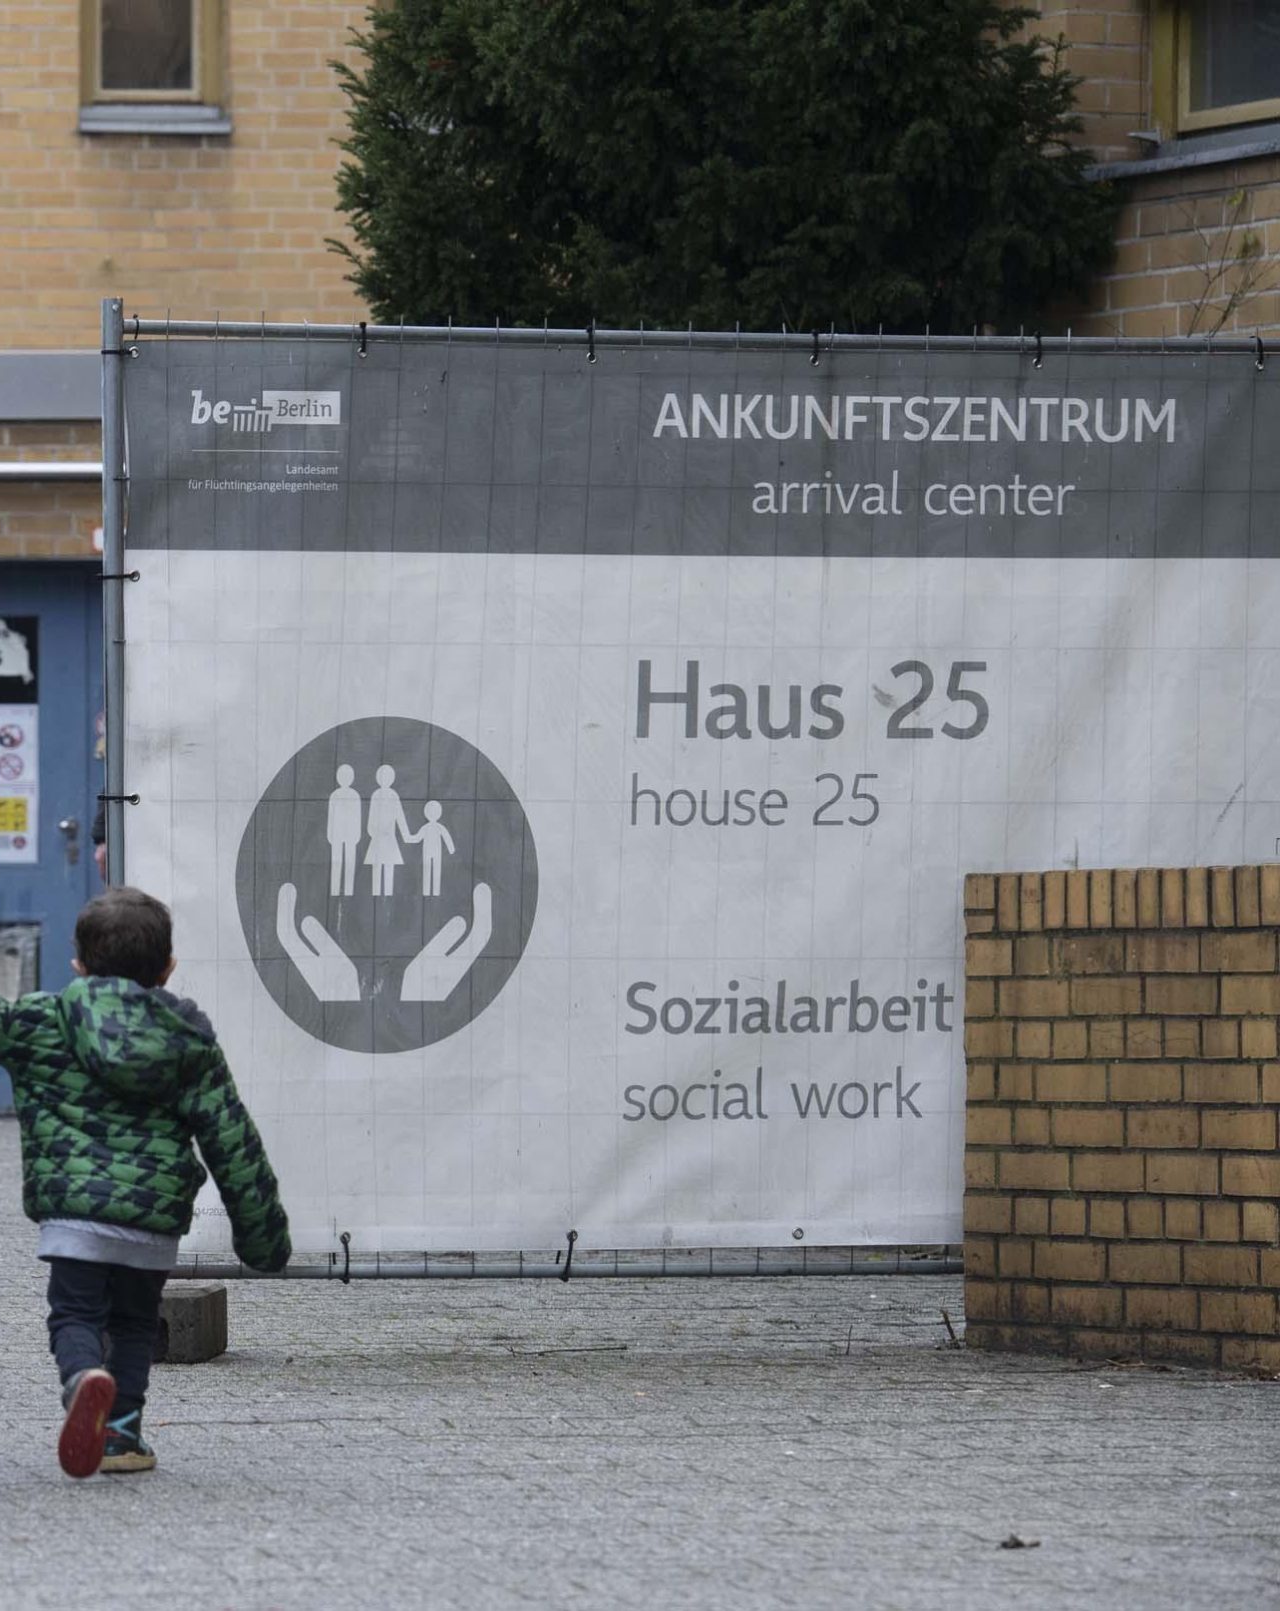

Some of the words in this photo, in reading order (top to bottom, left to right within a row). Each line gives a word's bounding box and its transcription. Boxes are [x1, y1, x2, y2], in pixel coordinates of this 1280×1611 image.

[191, 389, 232, 424] be
[276, 399, 333, 418] Berlin
[652, 392, 1177, 443] ANKUNFTSZENTRUM
[188, 478, 203, 490] für
[205, 479, 338, 493] Flüchtlingsangelegenheiten
[285, 463, 339, 475] Landesamt
[751, 470, 902, 515] arrival
[924, 475, 1075, 516] center
[635, 659, 845, 740] Haus
[886, 659, 989, 740] 25
[630, 772, 788, 826] house
[812, 773, 880, 826] 25
[624, 978, 954, 1035] Sozialarbeit
[622, 1066, 769, 1122] social
[790, 1066, 923, 1119] work
